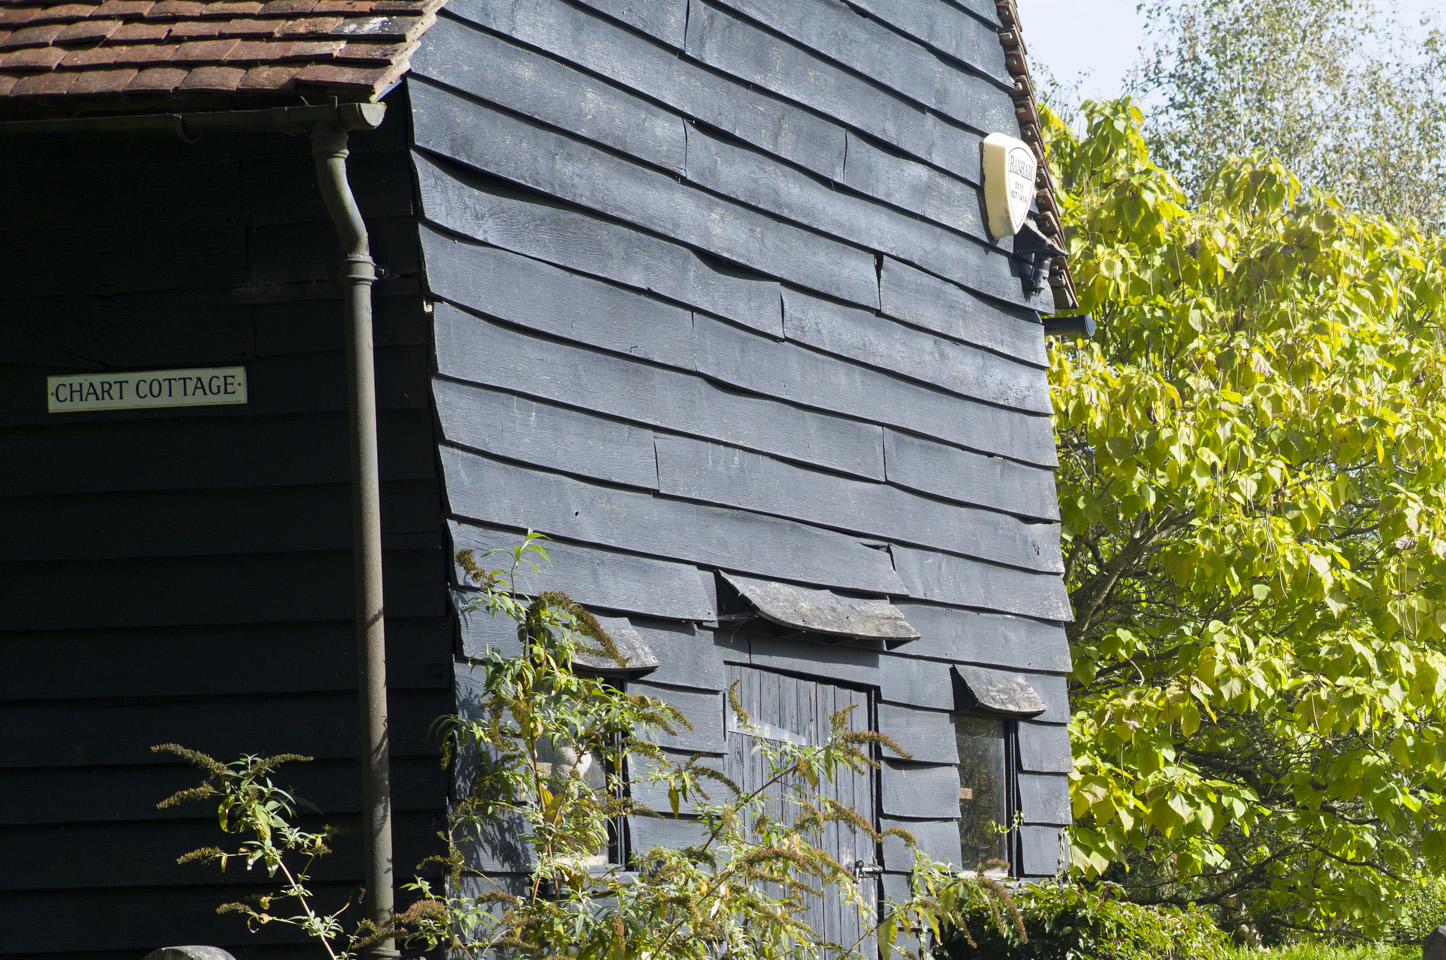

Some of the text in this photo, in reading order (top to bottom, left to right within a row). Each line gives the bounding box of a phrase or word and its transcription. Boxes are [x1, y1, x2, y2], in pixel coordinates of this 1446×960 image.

[1009, 154, 1033, 178] BANHAM
[55, 375, 236, 402] CHART COTTAGE
